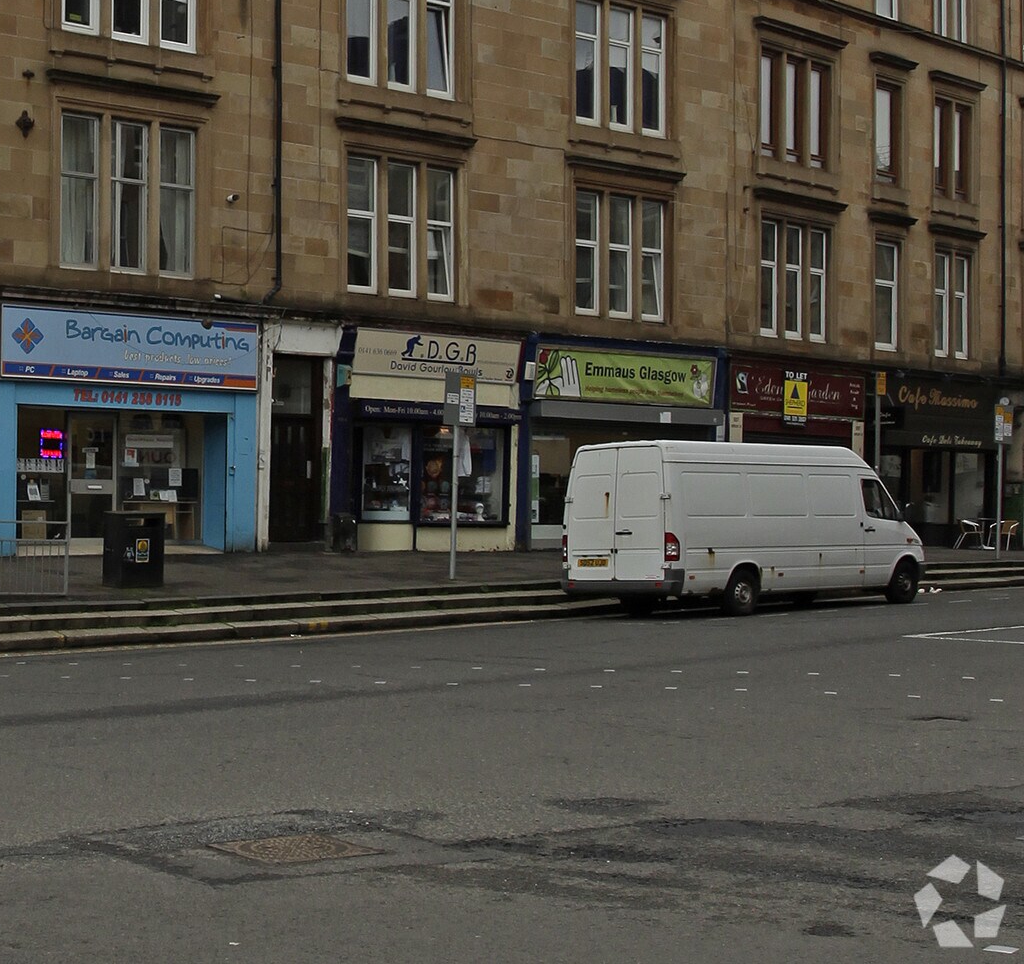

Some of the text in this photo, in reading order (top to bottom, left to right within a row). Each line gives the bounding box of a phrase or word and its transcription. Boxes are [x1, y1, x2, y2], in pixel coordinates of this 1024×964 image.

[124, 349, 141, 361] best
[24, 365, 36, 374] PC
[390, 360, 417, 372] David
[67, 368, 89, 377] Laptop
[113, 370, 130, 379] Sales
[154, 373, 177, 382] Repairs
[585, 361, 687, 385] Emmaus Glasgow
[785, 370, 795, 379] TO
[796, 371, 808, 380] LET
[193, 375, 221, 385] Upgrades
[808, 380, 841, 400] arden
[101, 390, 128, 404] 0141
[898, 385, 978, 411] Cafe Massimo
[384, 406, 406, 414] Mon-Fri
[921, 434, 937, 446] Cafe
